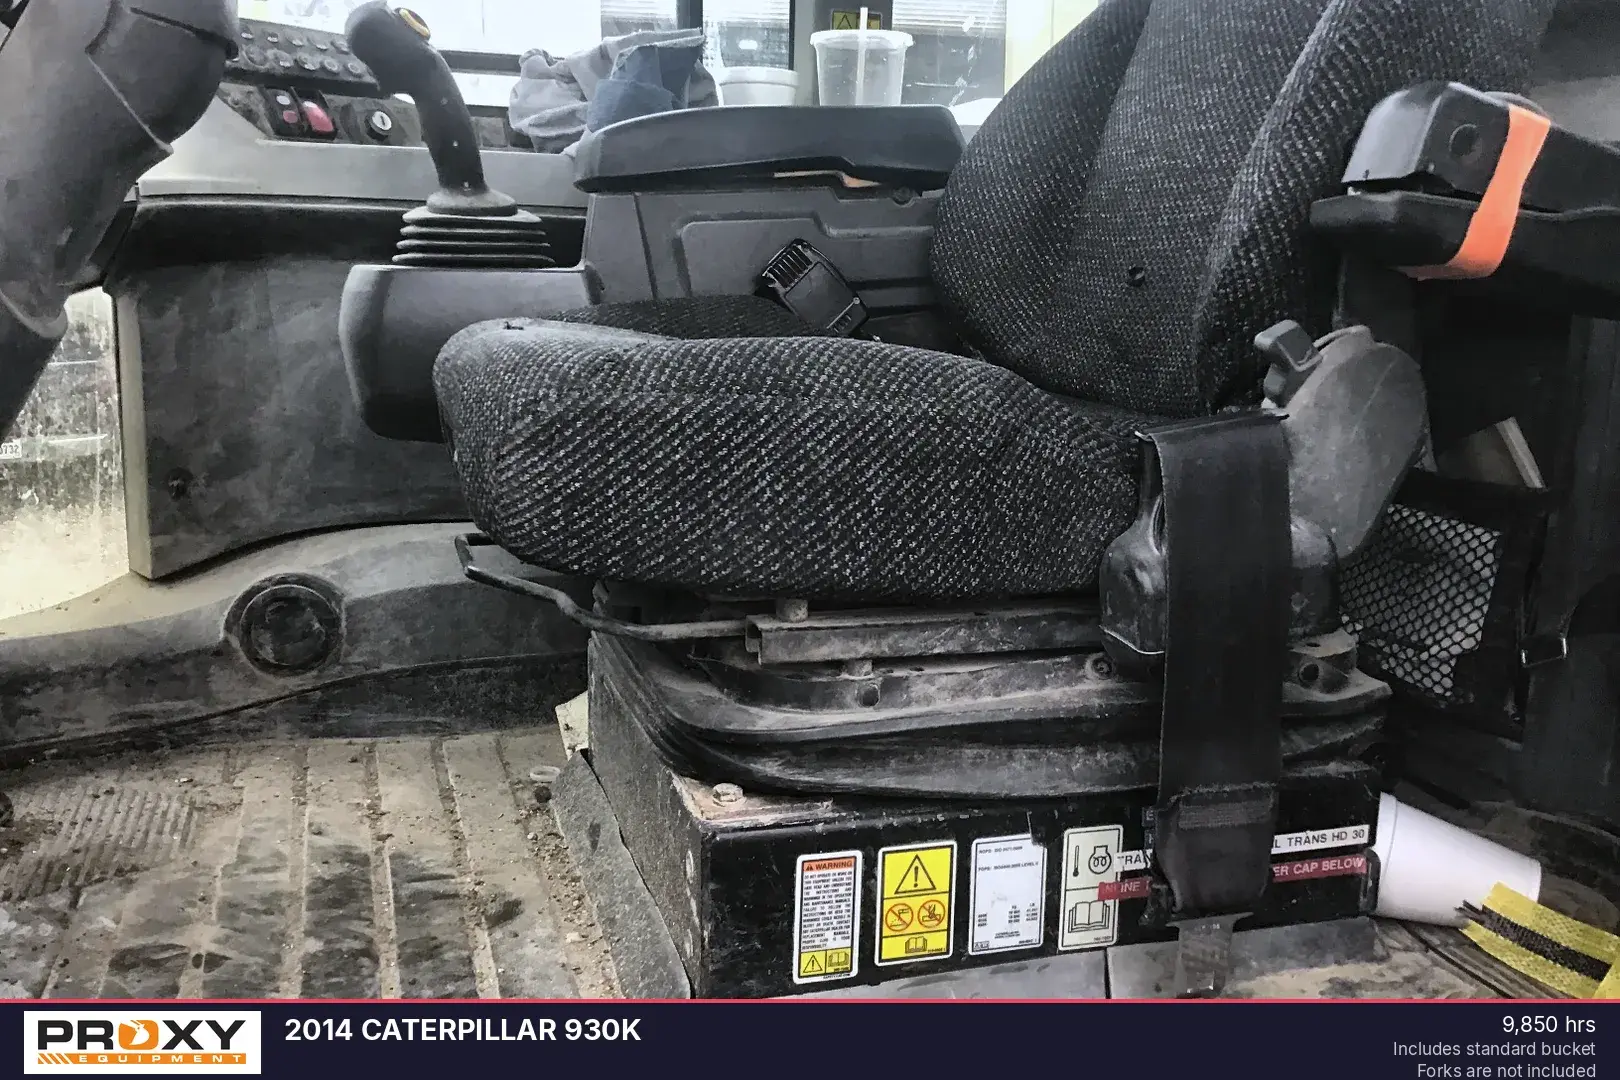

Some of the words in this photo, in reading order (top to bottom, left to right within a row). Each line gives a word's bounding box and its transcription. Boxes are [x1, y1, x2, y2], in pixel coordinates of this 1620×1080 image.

[1287, 834, 1328, 847] TRANS
[1332, 831, 1348, 842] HD
[1352, 828, 1365, 840] 30
[815, 860, 852, 870] WARNING
[1293, 862, 1318, 874] CAP
[1322, 858, 1364, 871] BELOW
